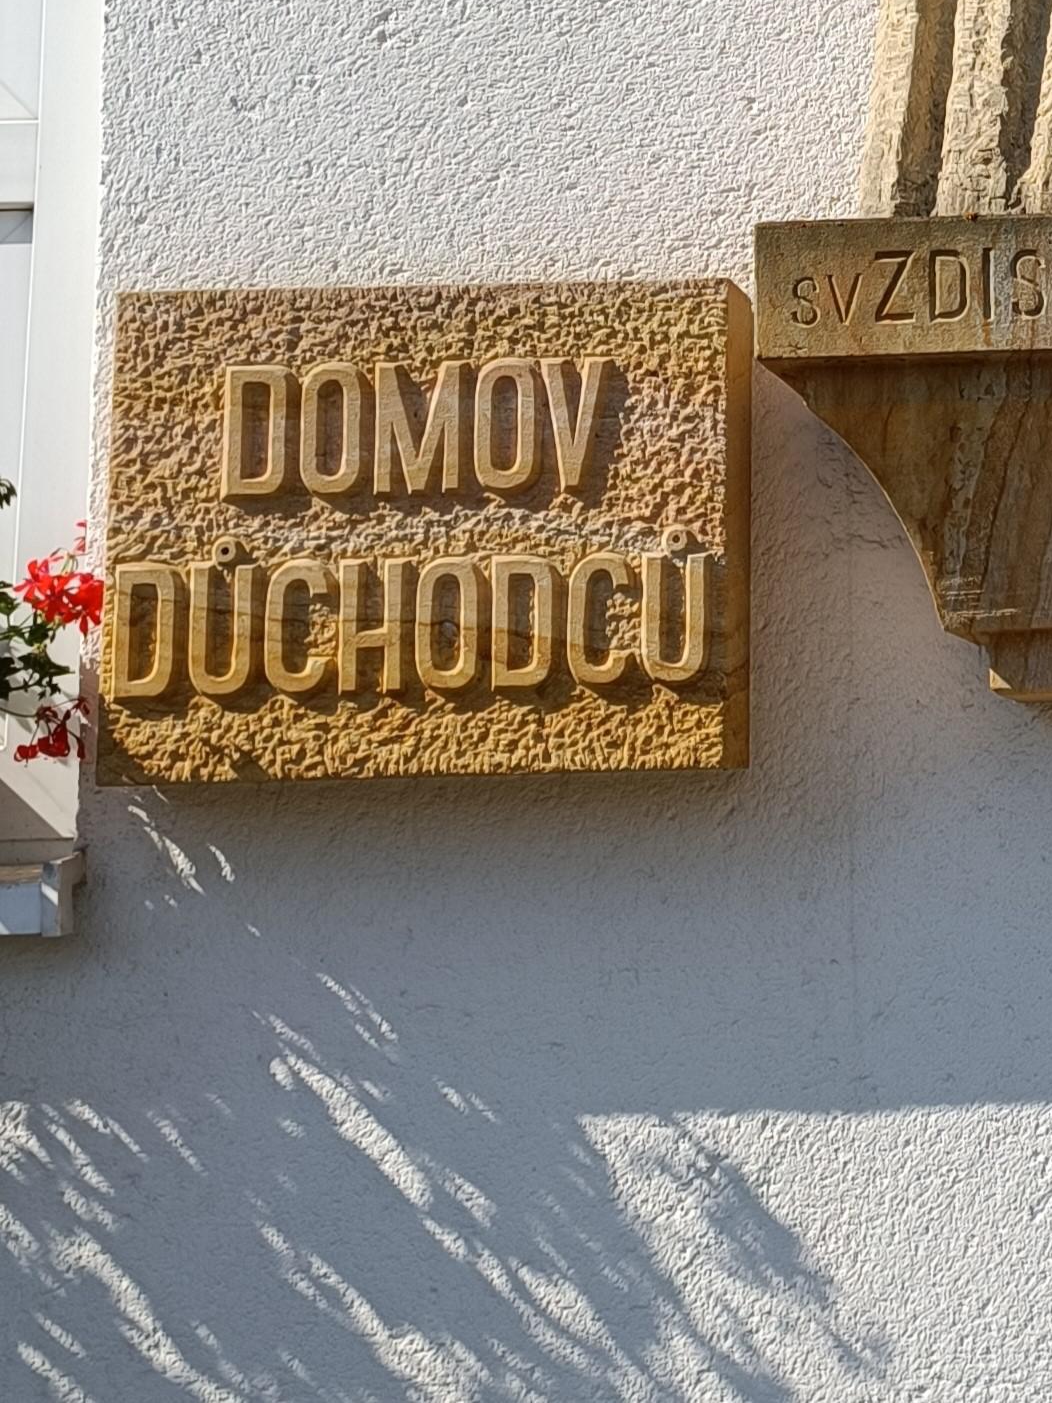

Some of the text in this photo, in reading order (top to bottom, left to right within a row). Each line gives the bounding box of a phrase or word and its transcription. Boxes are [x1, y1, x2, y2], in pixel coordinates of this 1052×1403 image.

[791, 272, 863, 328] SV
[220, 356, 615, 496] DOMOV
[112, 523, 713, 697] DŮCHODCŮ
